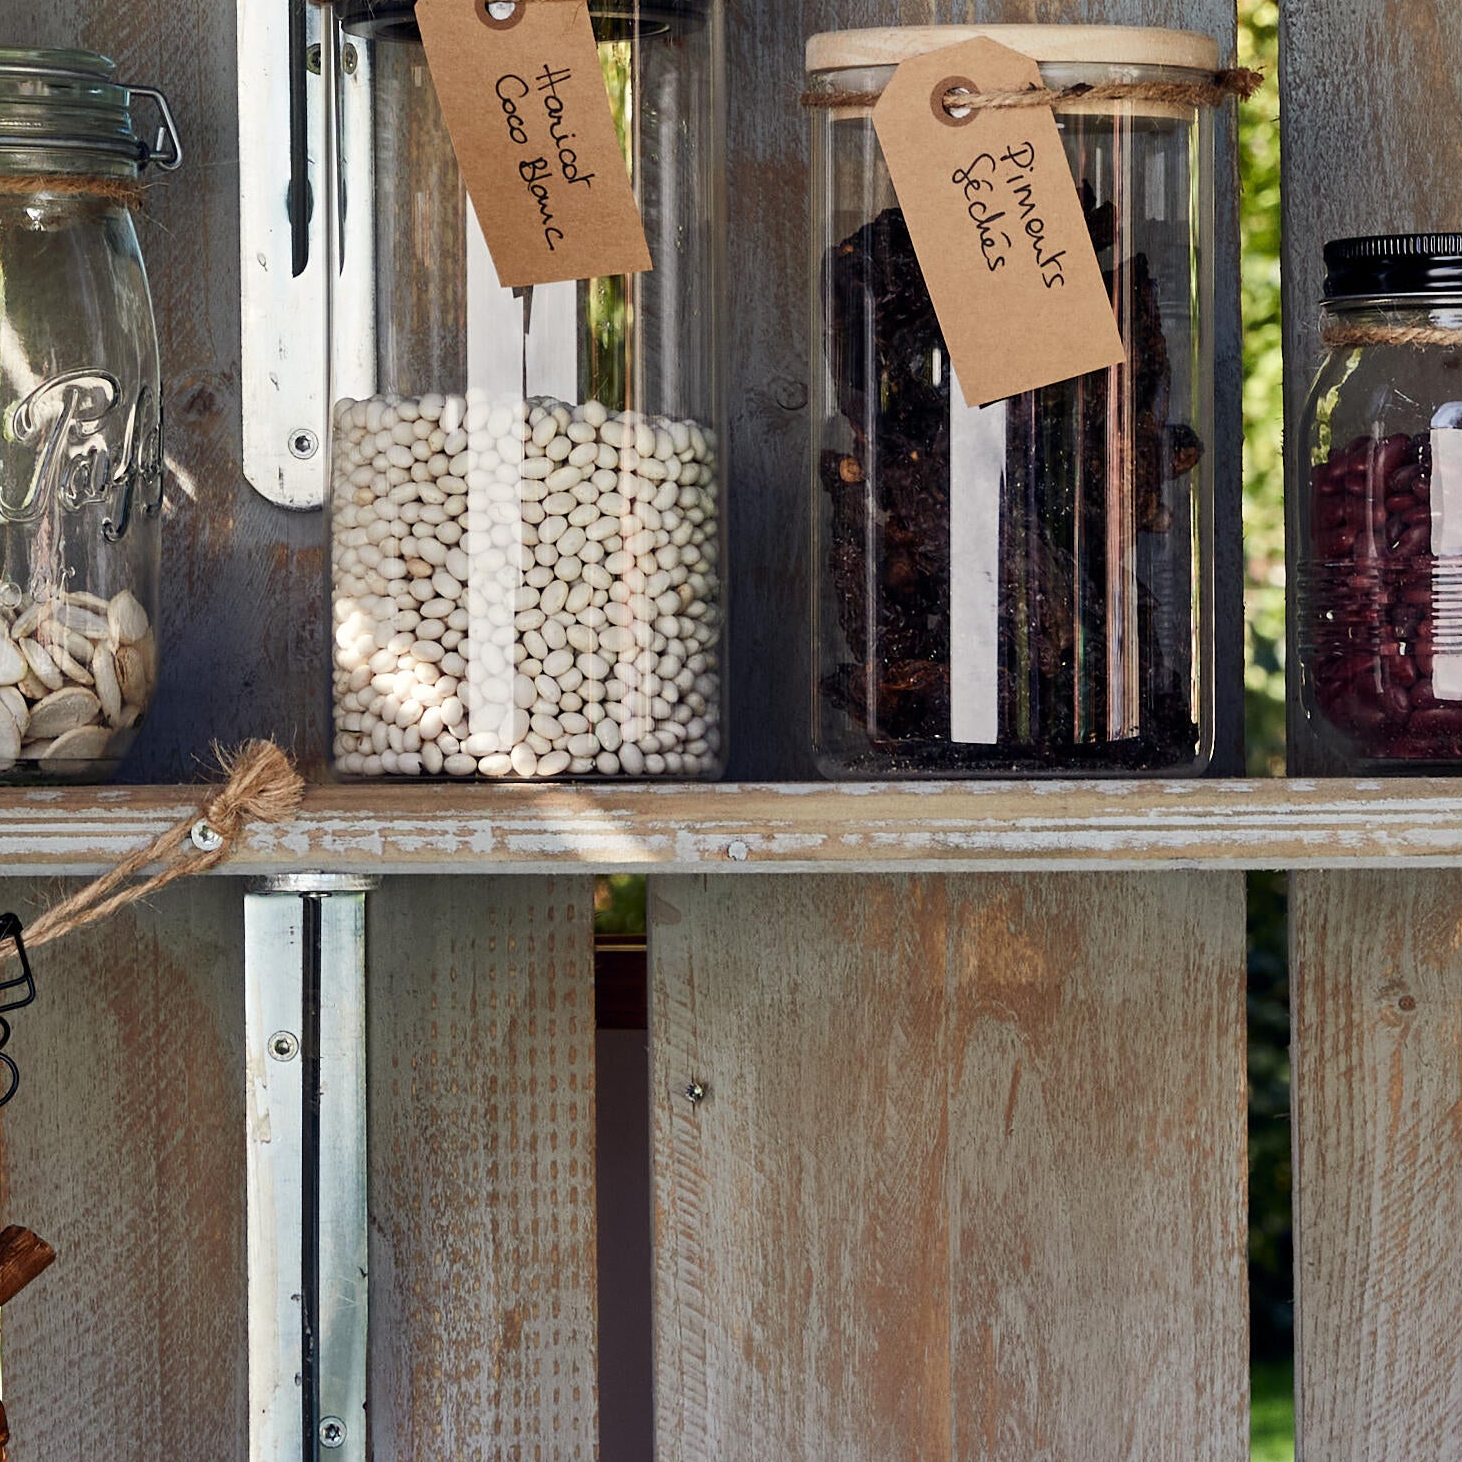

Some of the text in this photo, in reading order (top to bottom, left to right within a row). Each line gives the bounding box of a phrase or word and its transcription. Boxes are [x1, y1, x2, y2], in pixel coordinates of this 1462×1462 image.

[495, 74, 564, 251] Coco Blanc
[536, 64, 595, 188] Haricot
[1000, 141, 1066, 289] Piments
